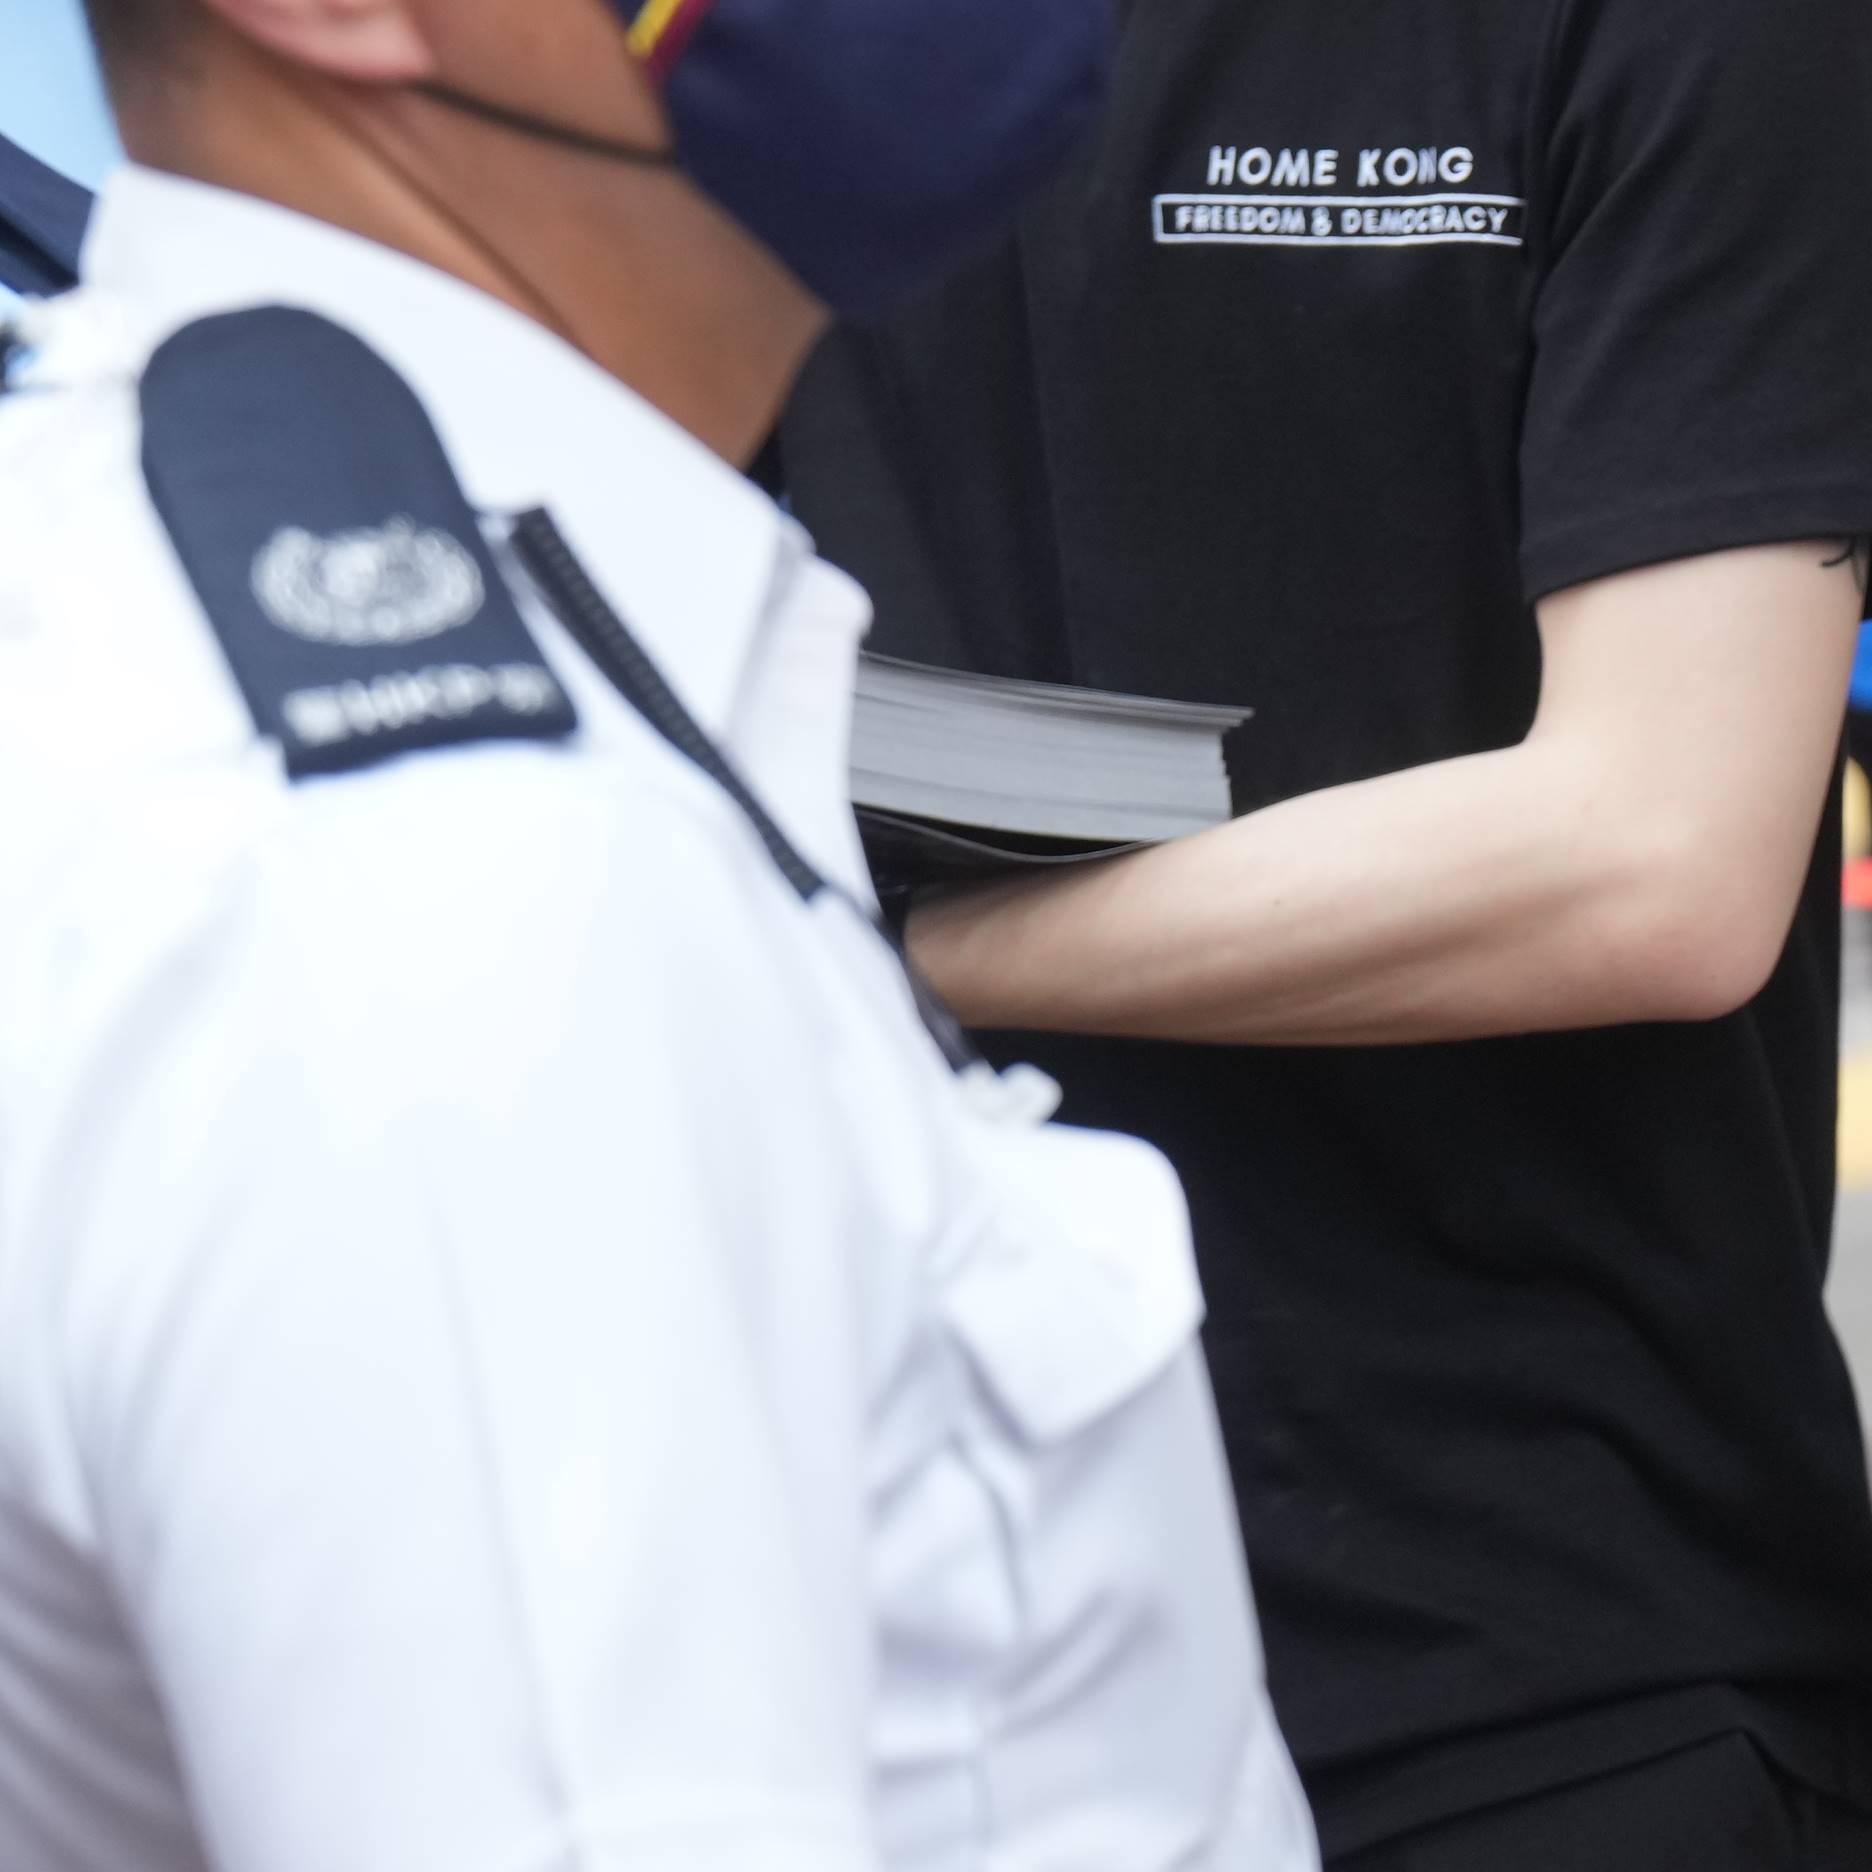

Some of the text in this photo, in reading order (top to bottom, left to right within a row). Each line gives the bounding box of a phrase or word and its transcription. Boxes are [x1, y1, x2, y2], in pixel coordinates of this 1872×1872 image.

[1207, 146, 1473, 187] HOME KONG
[1175, 205, 1507, 237] FREEDOM & DEMOCRACY
